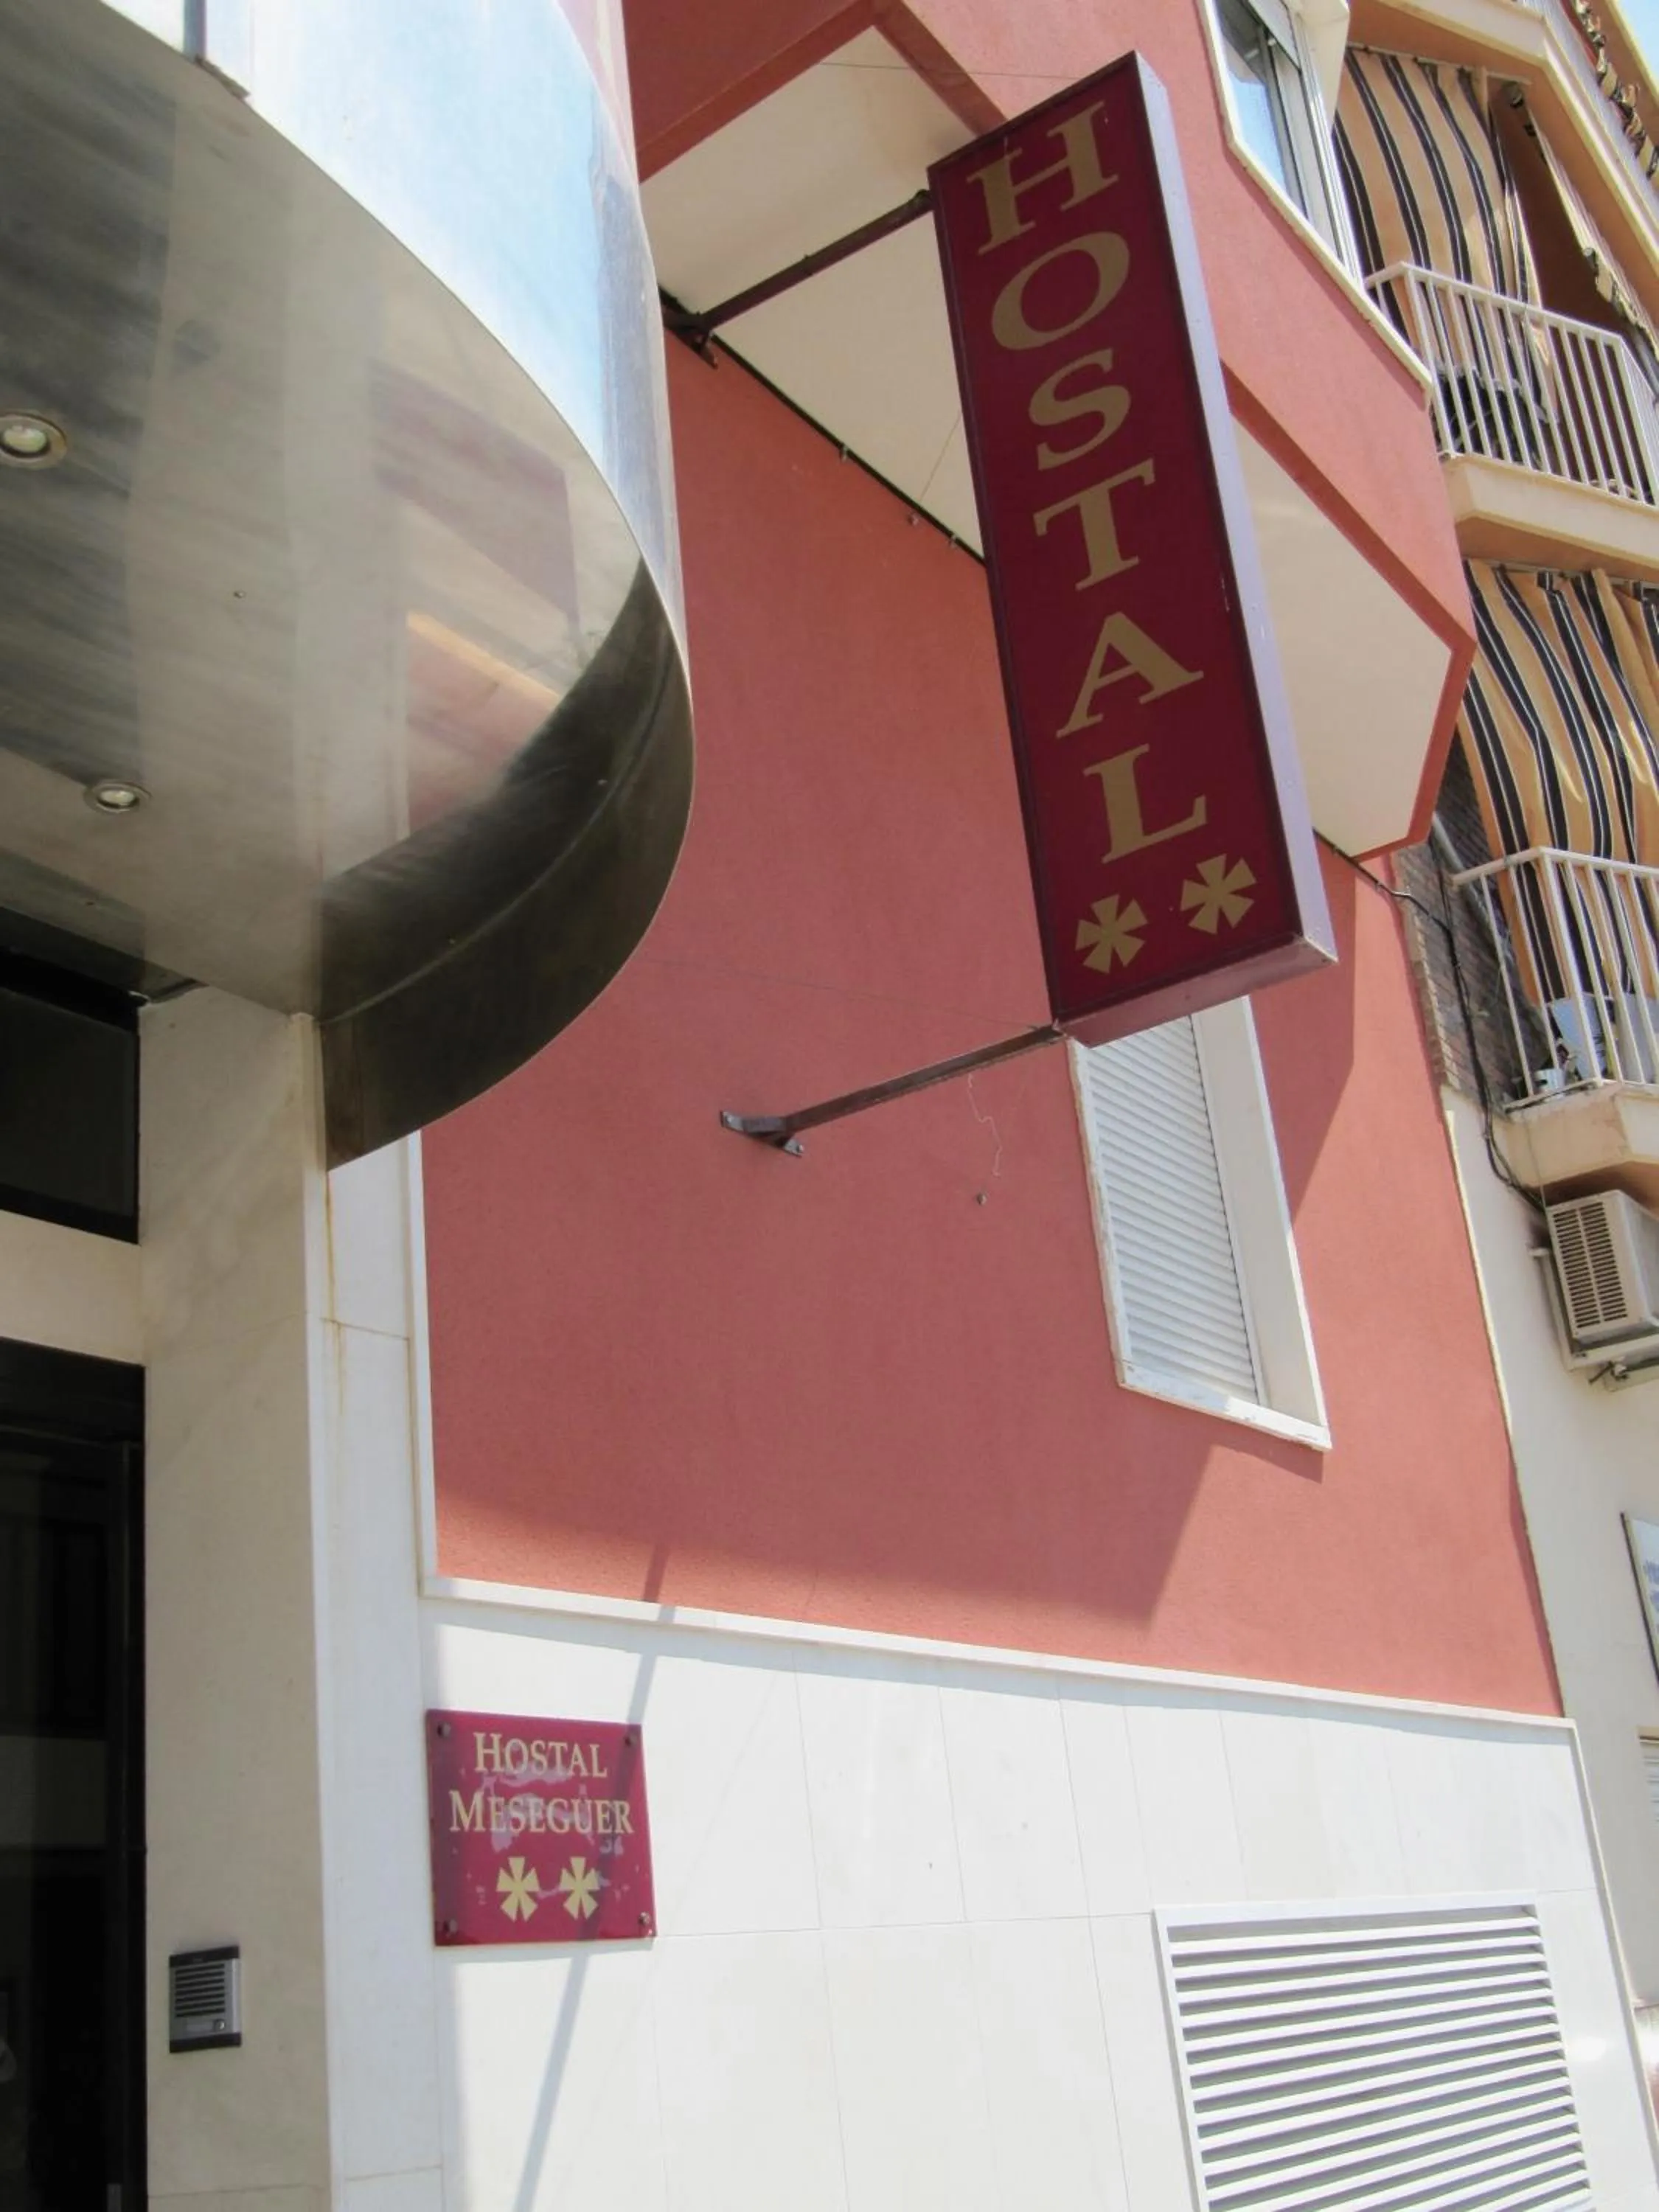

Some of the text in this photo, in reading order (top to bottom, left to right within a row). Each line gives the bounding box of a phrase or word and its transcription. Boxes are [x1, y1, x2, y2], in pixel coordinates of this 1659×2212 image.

[967, 102, 1206, 863] HOSTAL
[473, 1732, 608, 1777] HOSTAL
[449, 1790, 634, 1834] MESEGUER
